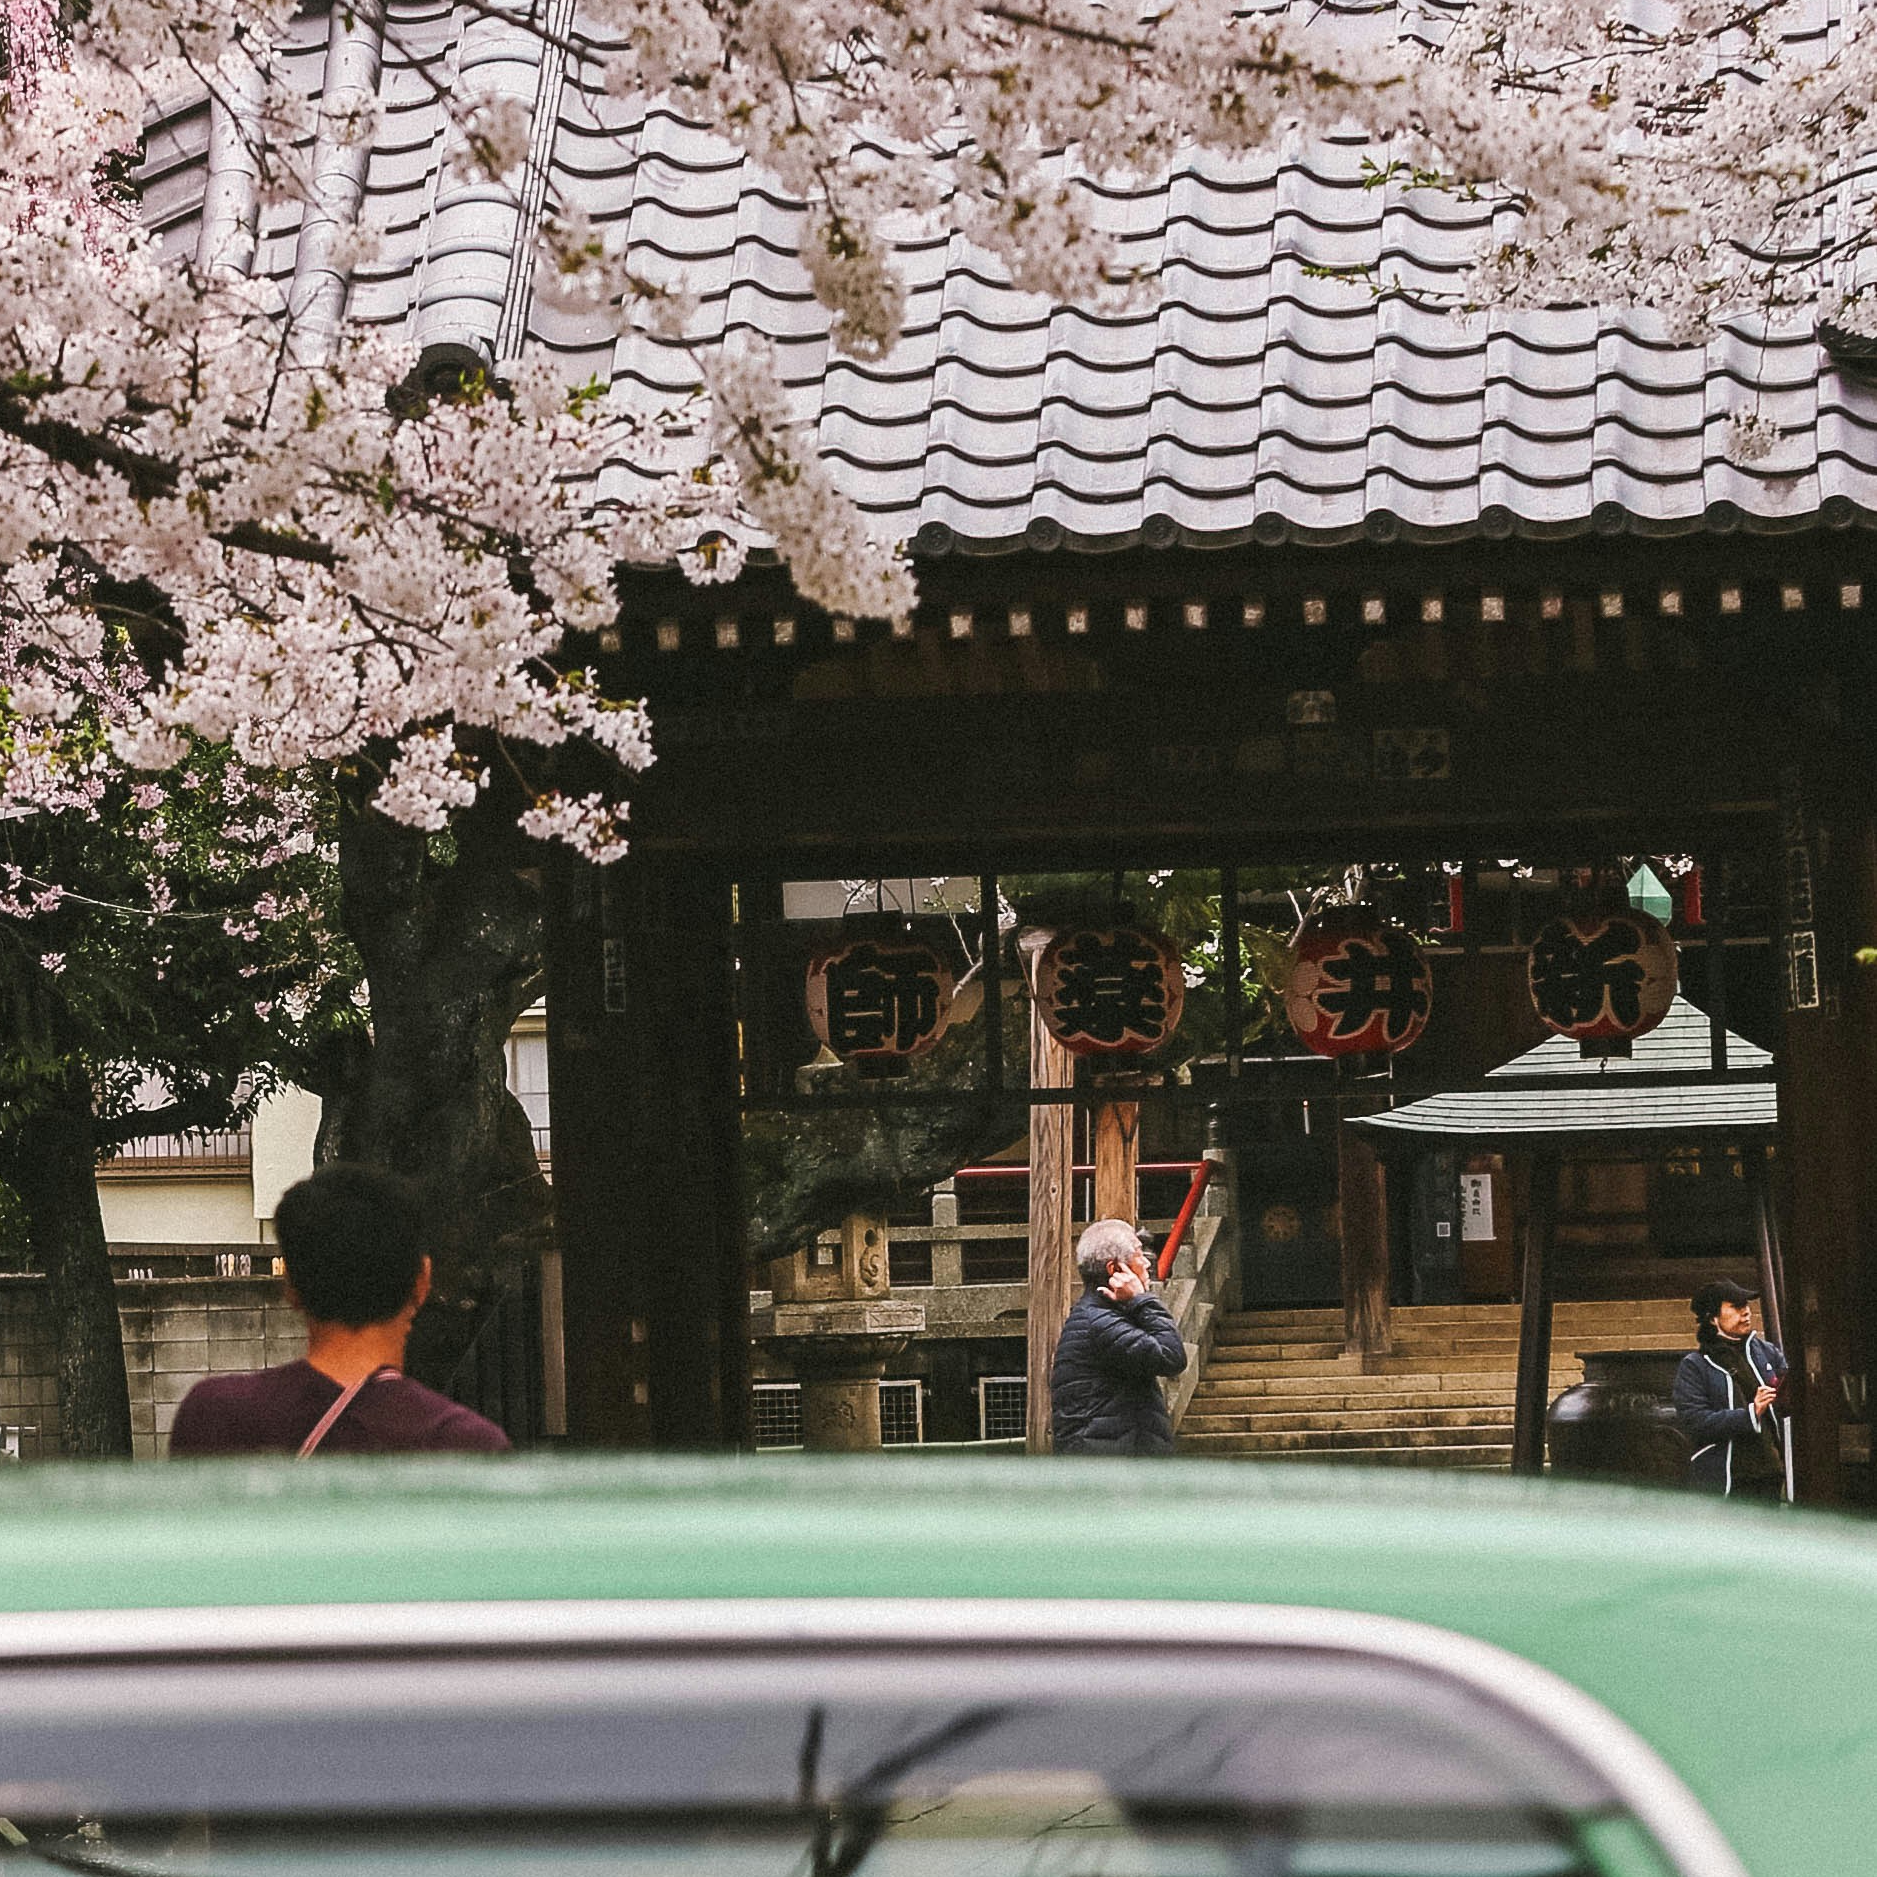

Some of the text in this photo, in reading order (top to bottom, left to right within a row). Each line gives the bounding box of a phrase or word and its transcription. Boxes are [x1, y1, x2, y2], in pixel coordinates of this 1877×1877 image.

[825, 945, 939, 1053] 師
[1316, 930, 1427, 1042] 井
[1531, 920, 1644, 1031] 新
